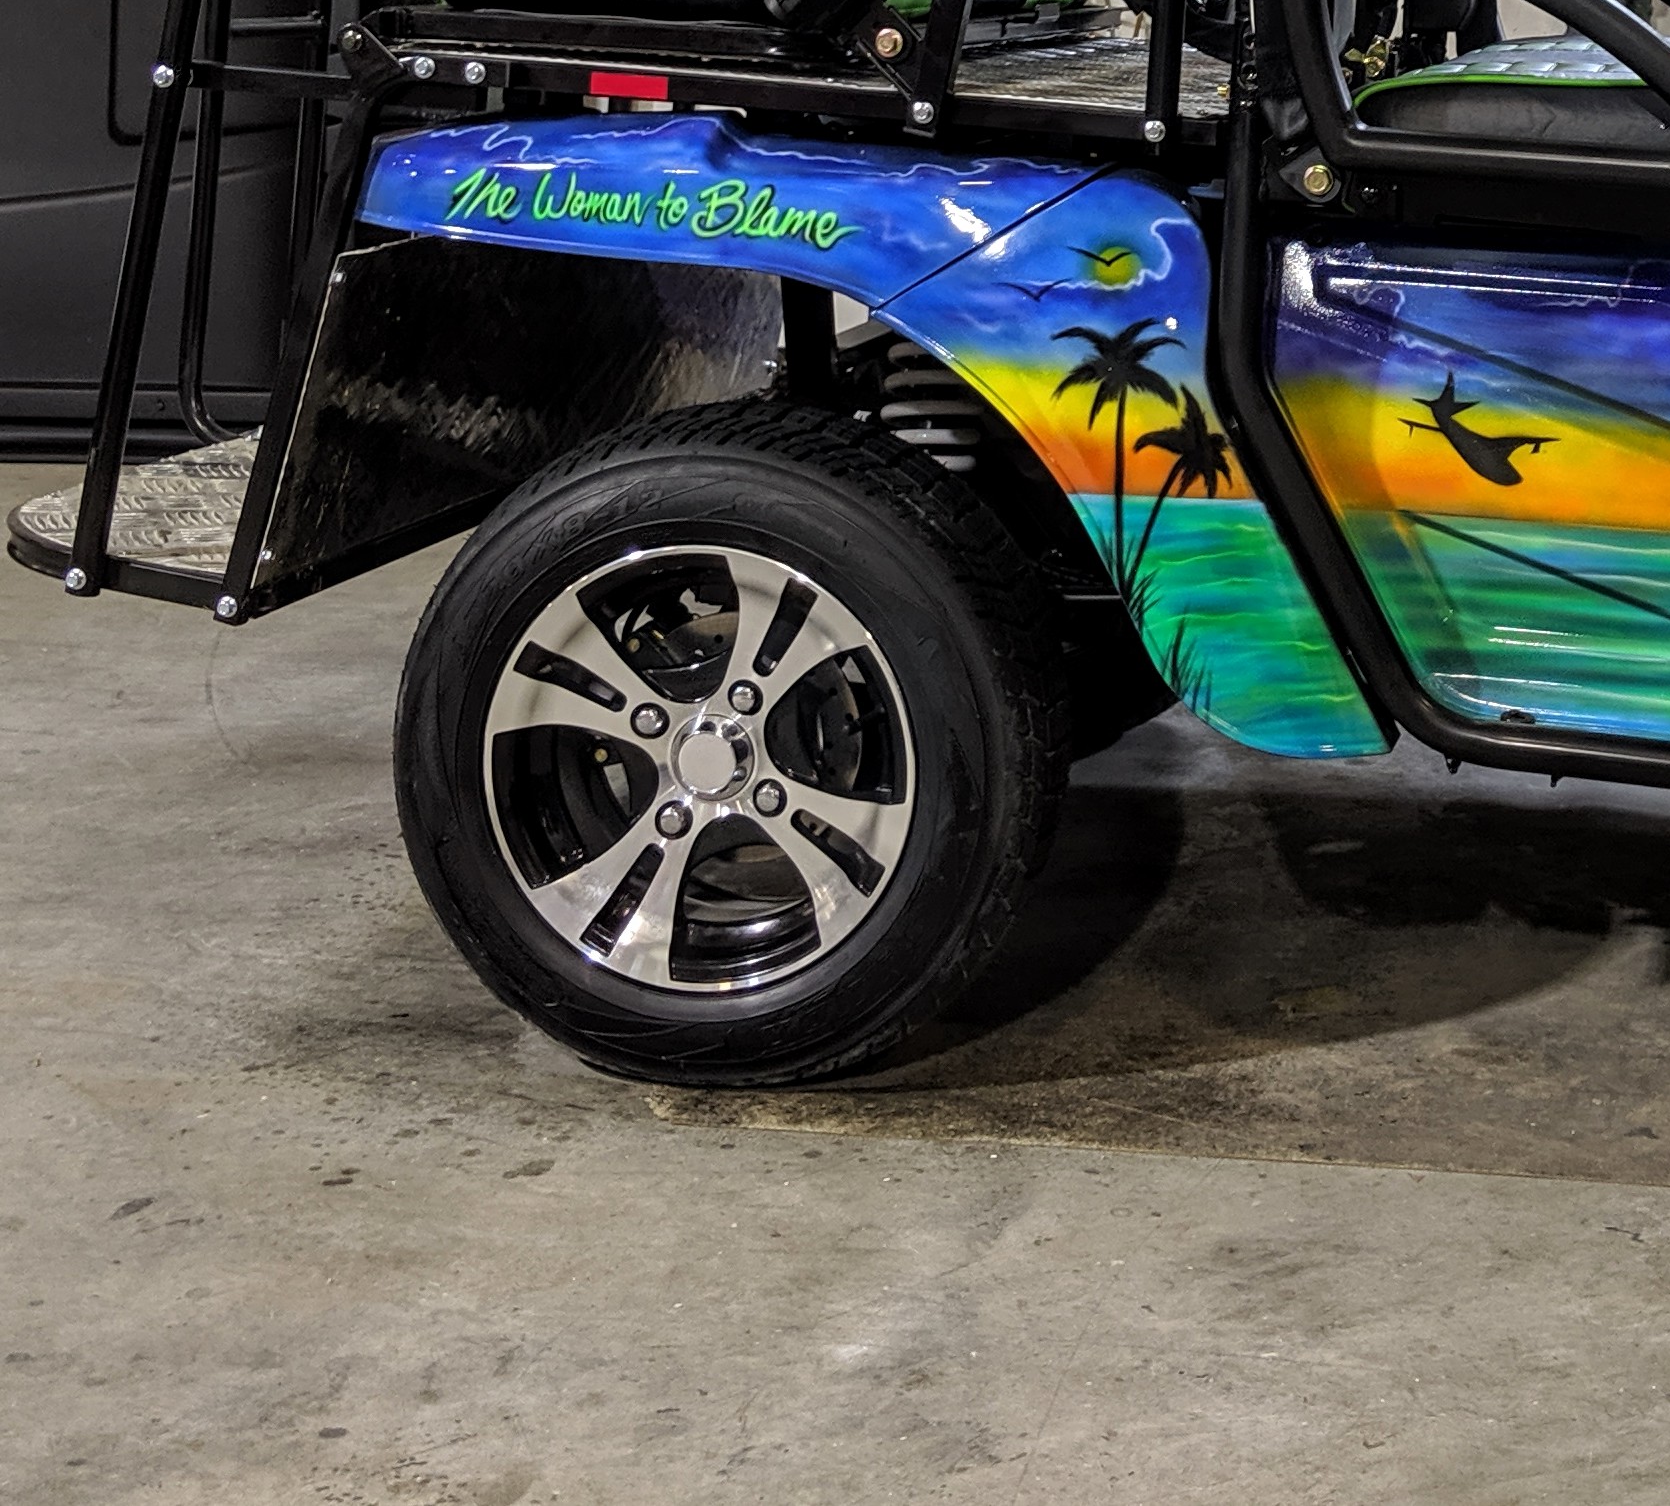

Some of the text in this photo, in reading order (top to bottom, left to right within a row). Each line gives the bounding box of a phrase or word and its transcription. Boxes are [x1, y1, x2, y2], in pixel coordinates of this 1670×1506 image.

[444, 167, 864, 250] The Woman to Blame
